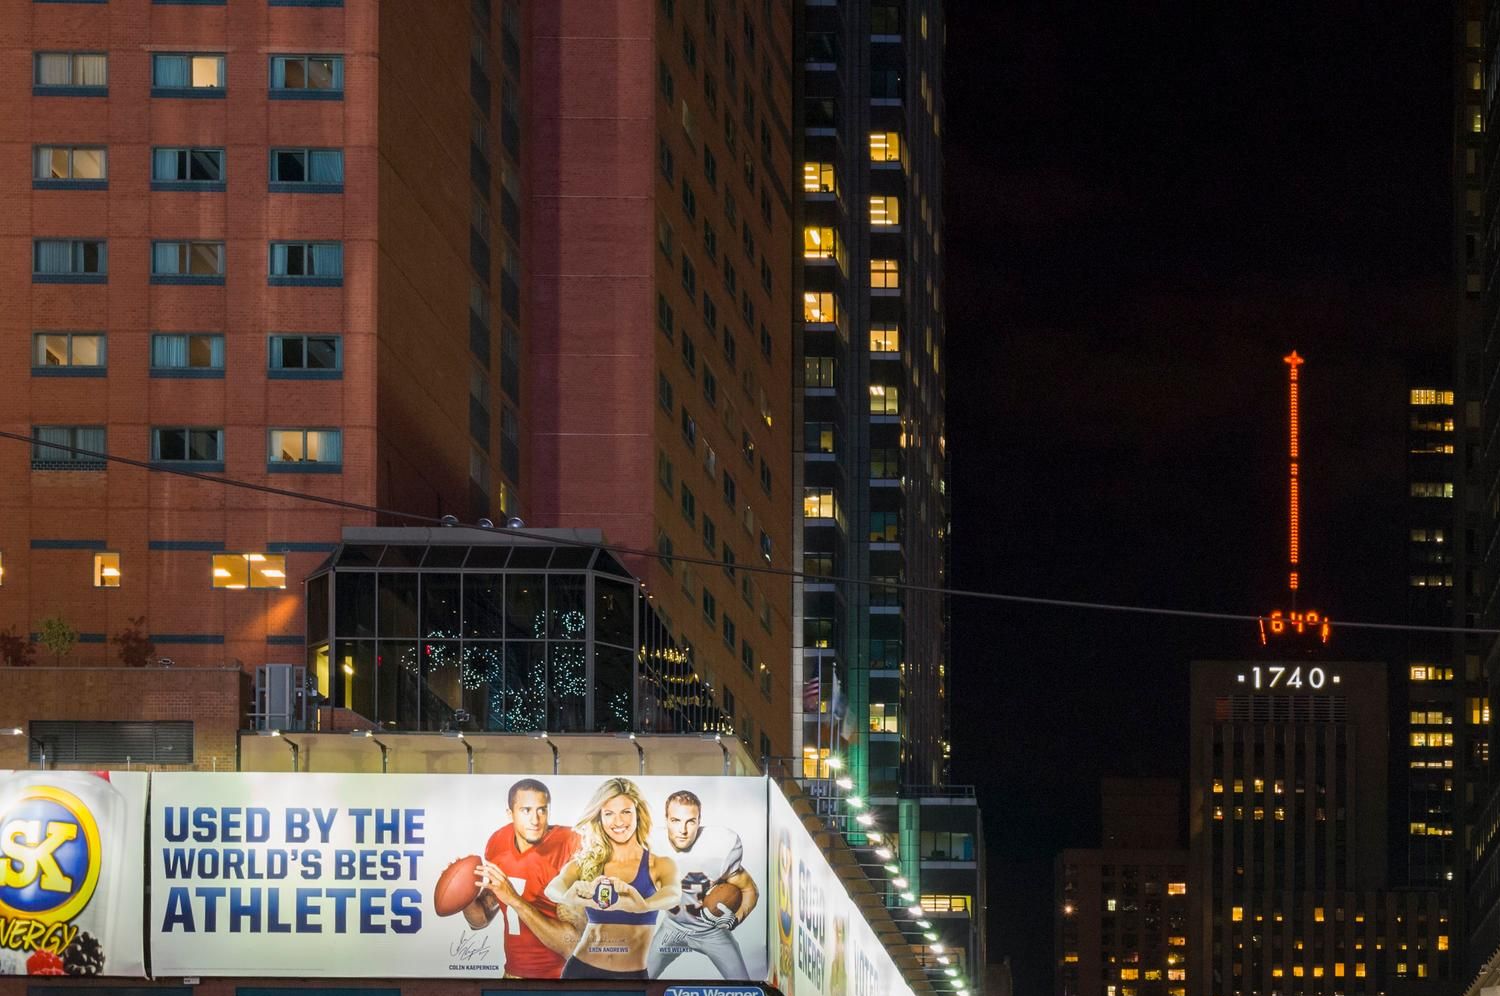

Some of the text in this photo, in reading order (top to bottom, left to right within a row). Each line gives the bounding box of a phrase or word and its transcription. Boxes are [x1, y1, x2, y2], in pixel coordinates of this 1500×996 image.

[1252, 666, 1325, 689] 1740
[164, 806, 425, 844] USED BY THE
[163, 848, 424, 880] WORLD'S BEST
[161, 887, 422, 934] ATHLETES
[798, 924, 825, 995] ENERGY
